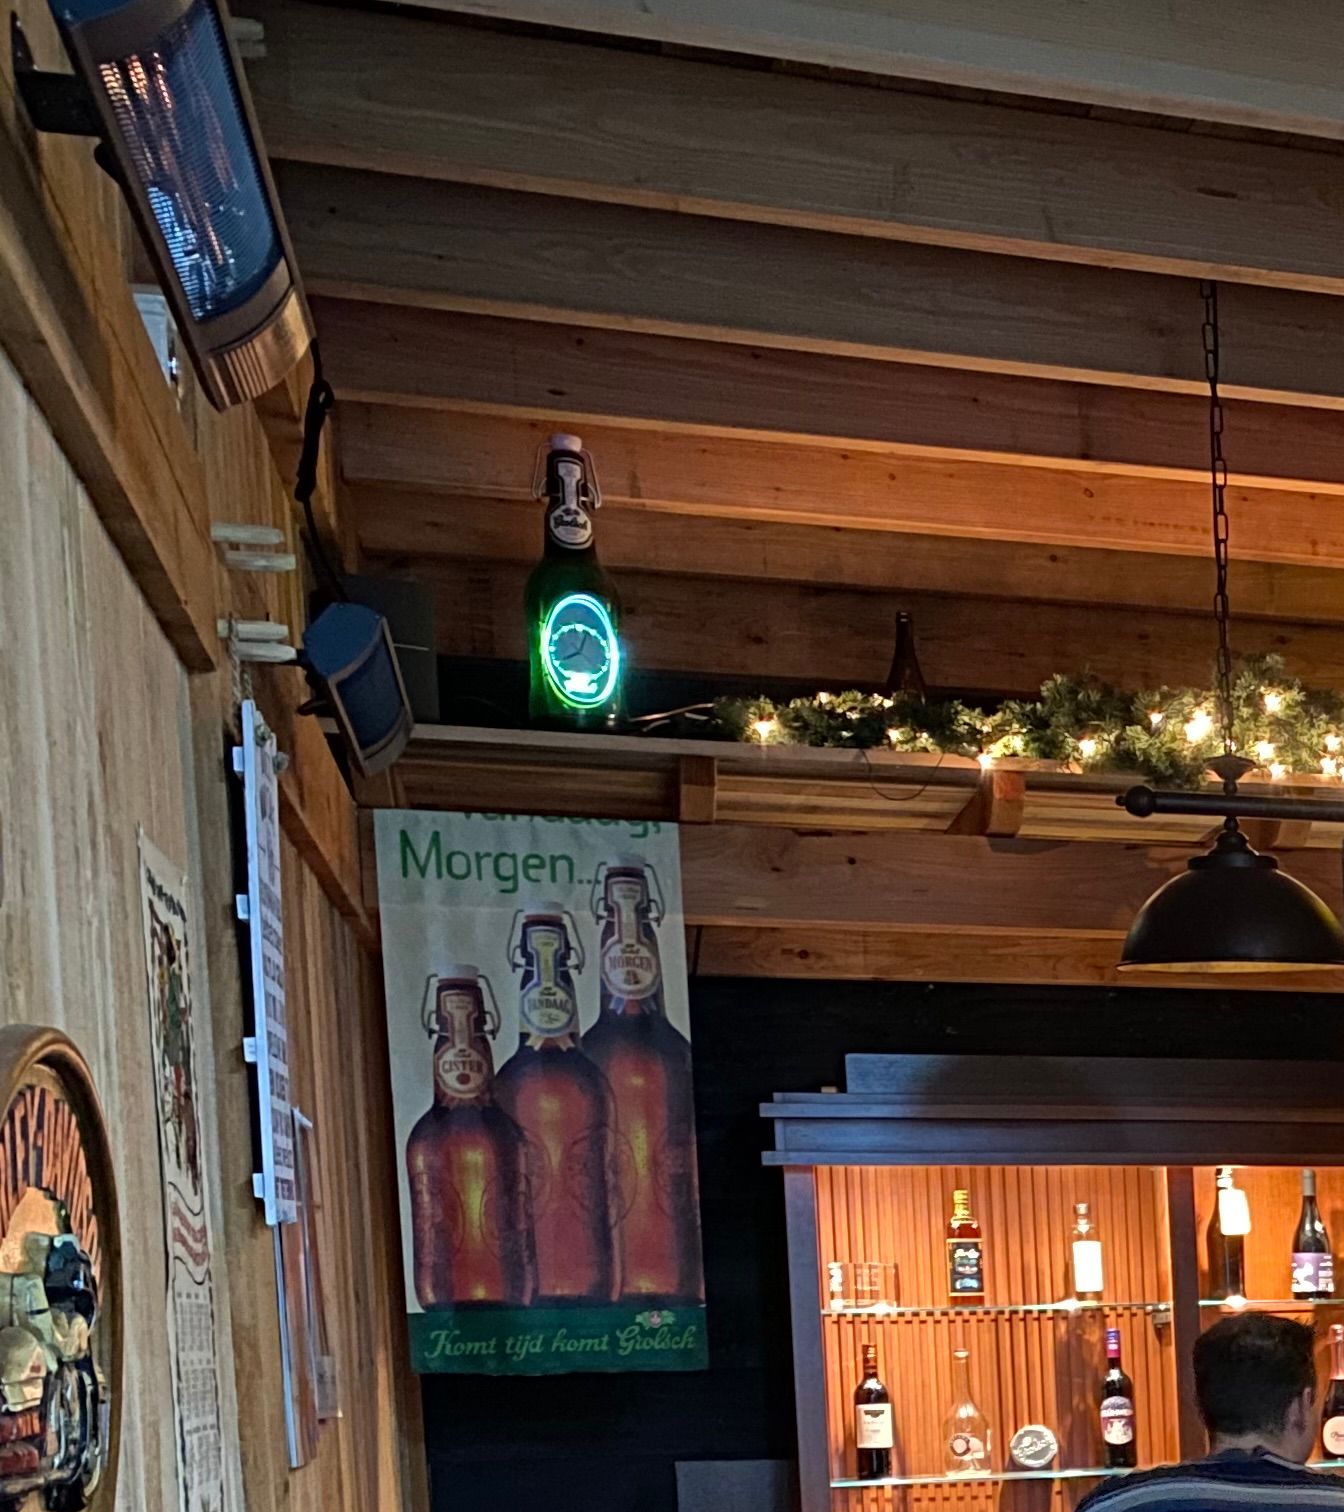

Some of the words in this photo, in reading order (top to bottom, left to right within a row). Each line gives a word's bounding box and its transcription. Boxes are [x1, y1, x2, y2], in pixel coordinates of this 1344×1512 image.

[424, 1330, 497, 1359] Komt
[505, 1334, 543, 1361] tijd
[551, 1328, 610, 1352] komt
[616, 1325, 697, 1356] Grolsch
